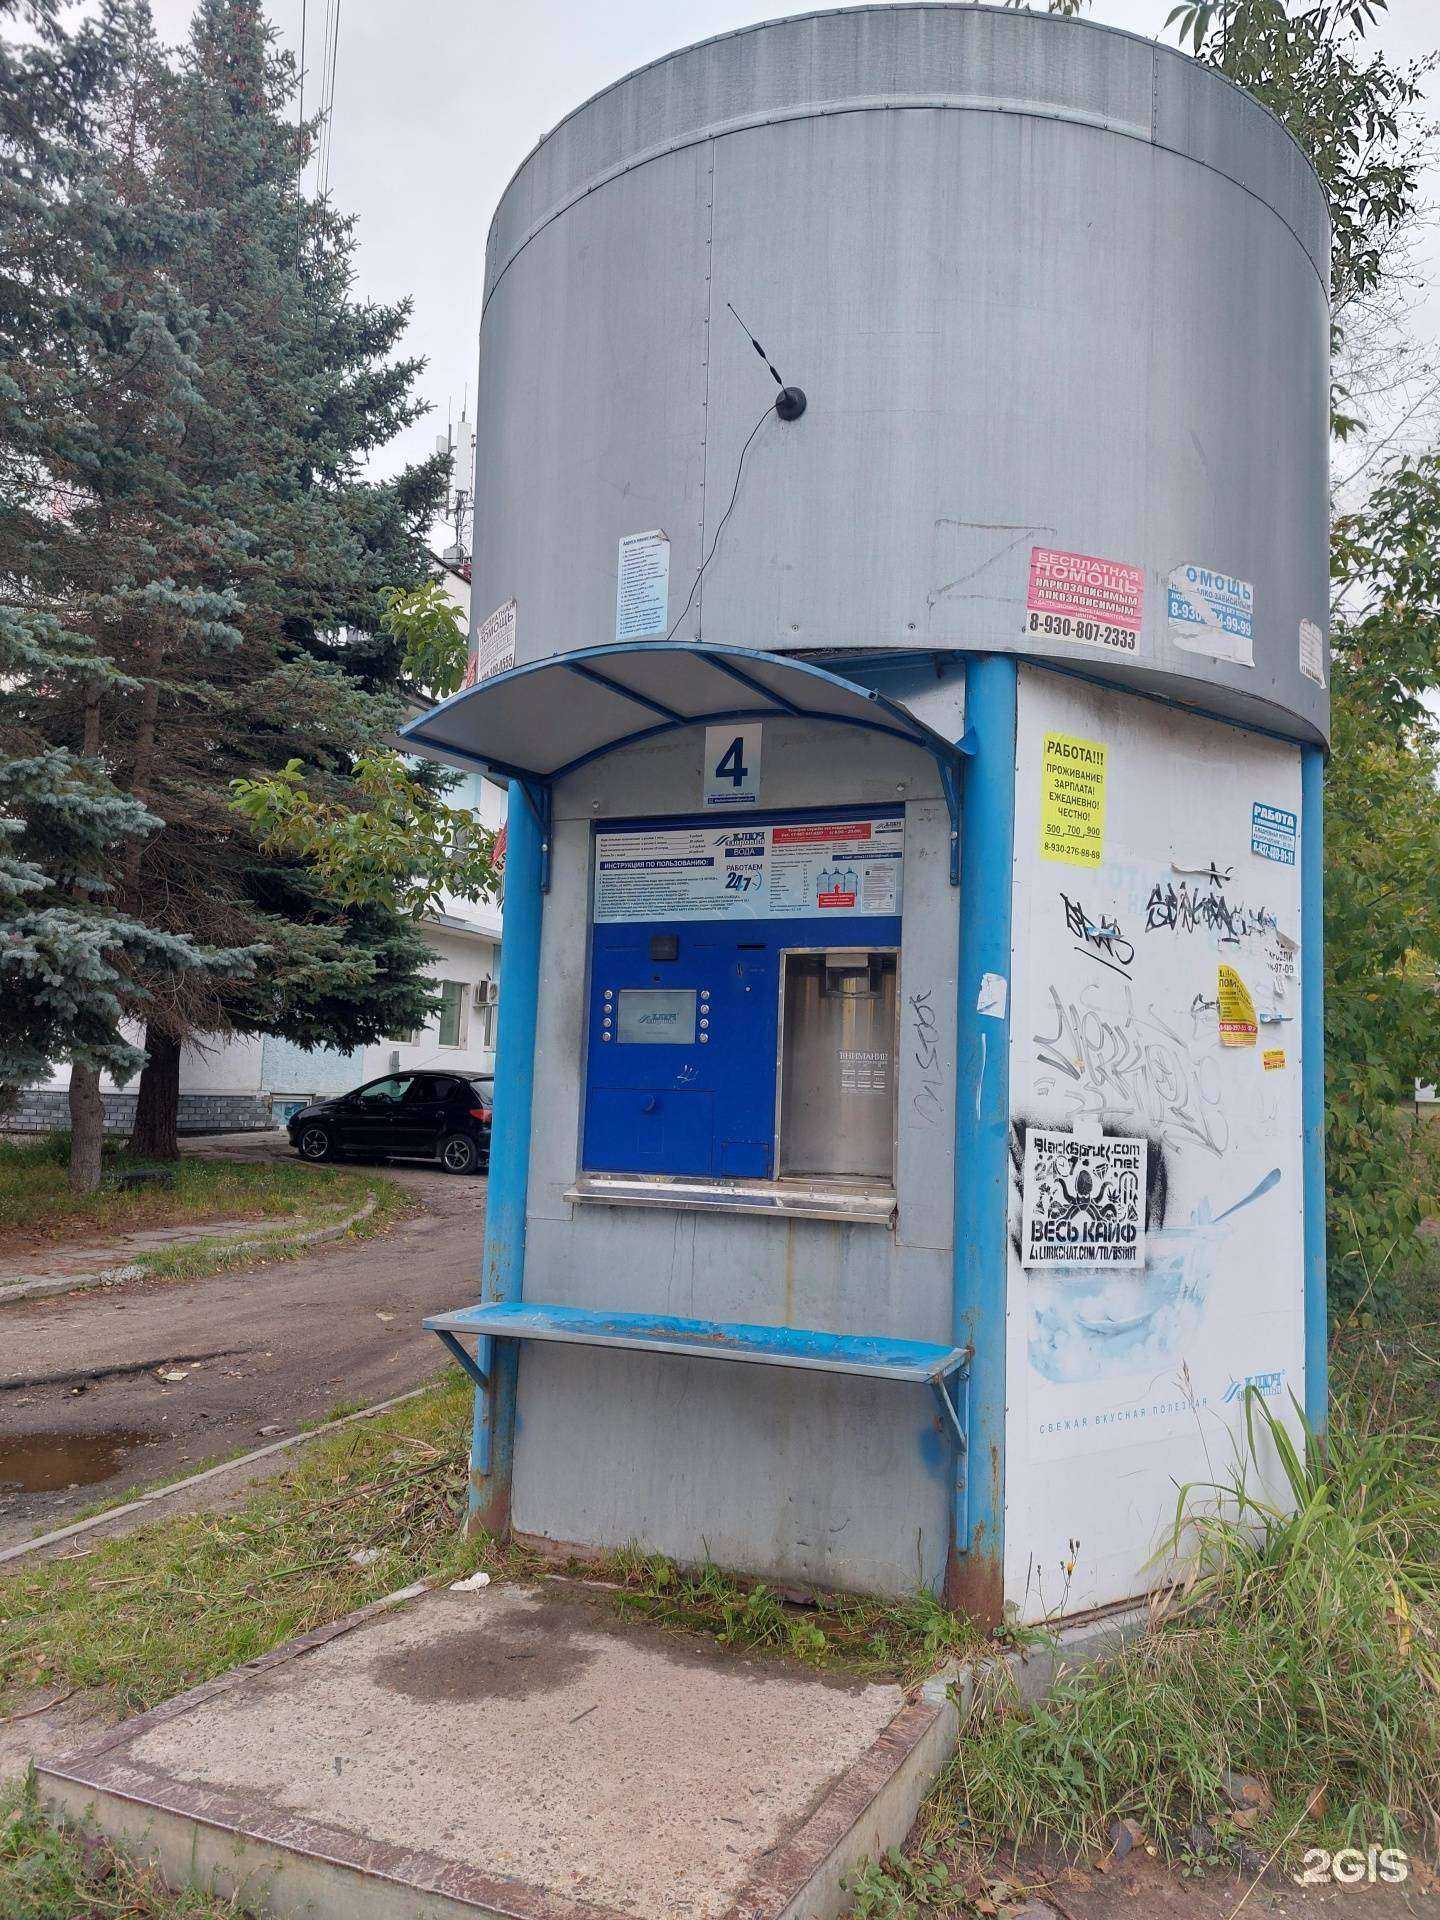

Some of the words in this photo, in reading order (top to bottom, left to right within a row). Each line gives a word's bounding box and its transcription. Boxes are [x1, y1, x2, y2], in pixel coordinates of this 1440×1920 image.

[1035, 563, 1138, 594] ПОМОЩЬ
[1038, 552, 1139, 581] БЕСПЛАТНАЯ
[1035, 577, 1138, 606] НАРКОЗАВИСИМЫМ
[1187, 567, 1251, 600] ОМОЩЬ
[1037, 590, 1134, 616] АЛКОЗАВИСИМЫМ
[1029, 612, 1136, 651] 8-930-807-2333
[716, 736, 748, 787] 4
[1047, 740, 1104, 765] РАБОТА!!!
[1046, 763, 1103, 784] ПРОЖИВАНИЕ!
[1054, 778, 1095, 796] ЗАРПЛАТА!
[1049, 791, 1100, 810] ЕЖЕДНЕВНО!
[1057, 807, 1091, 821] ЧЕСТНО!
[1254, 805, 1295, 828] РАБОТА
[1046, 824, 1061, 834] 500
[1067, 825, 1081, 835] 700
[1086, 825, 1101, 836] 900
[733, 848, 756, 856] ВОДА
[604, 862, 645, 870] ИНСТРУКЦИЯ
[656, 859, 709, 867] ПОЛЬЗОВАНИЮ:
[1031, 1220, 1080, 1243] ВЕСЬ
[1039, 1417, 1088, 1434] СВЕЖАЯ
[1095, 1408, 1147, 1425] ВКУСНАЯ
[1152, 1398, 1208, 1415] ПОЛЕЗНАЯ
